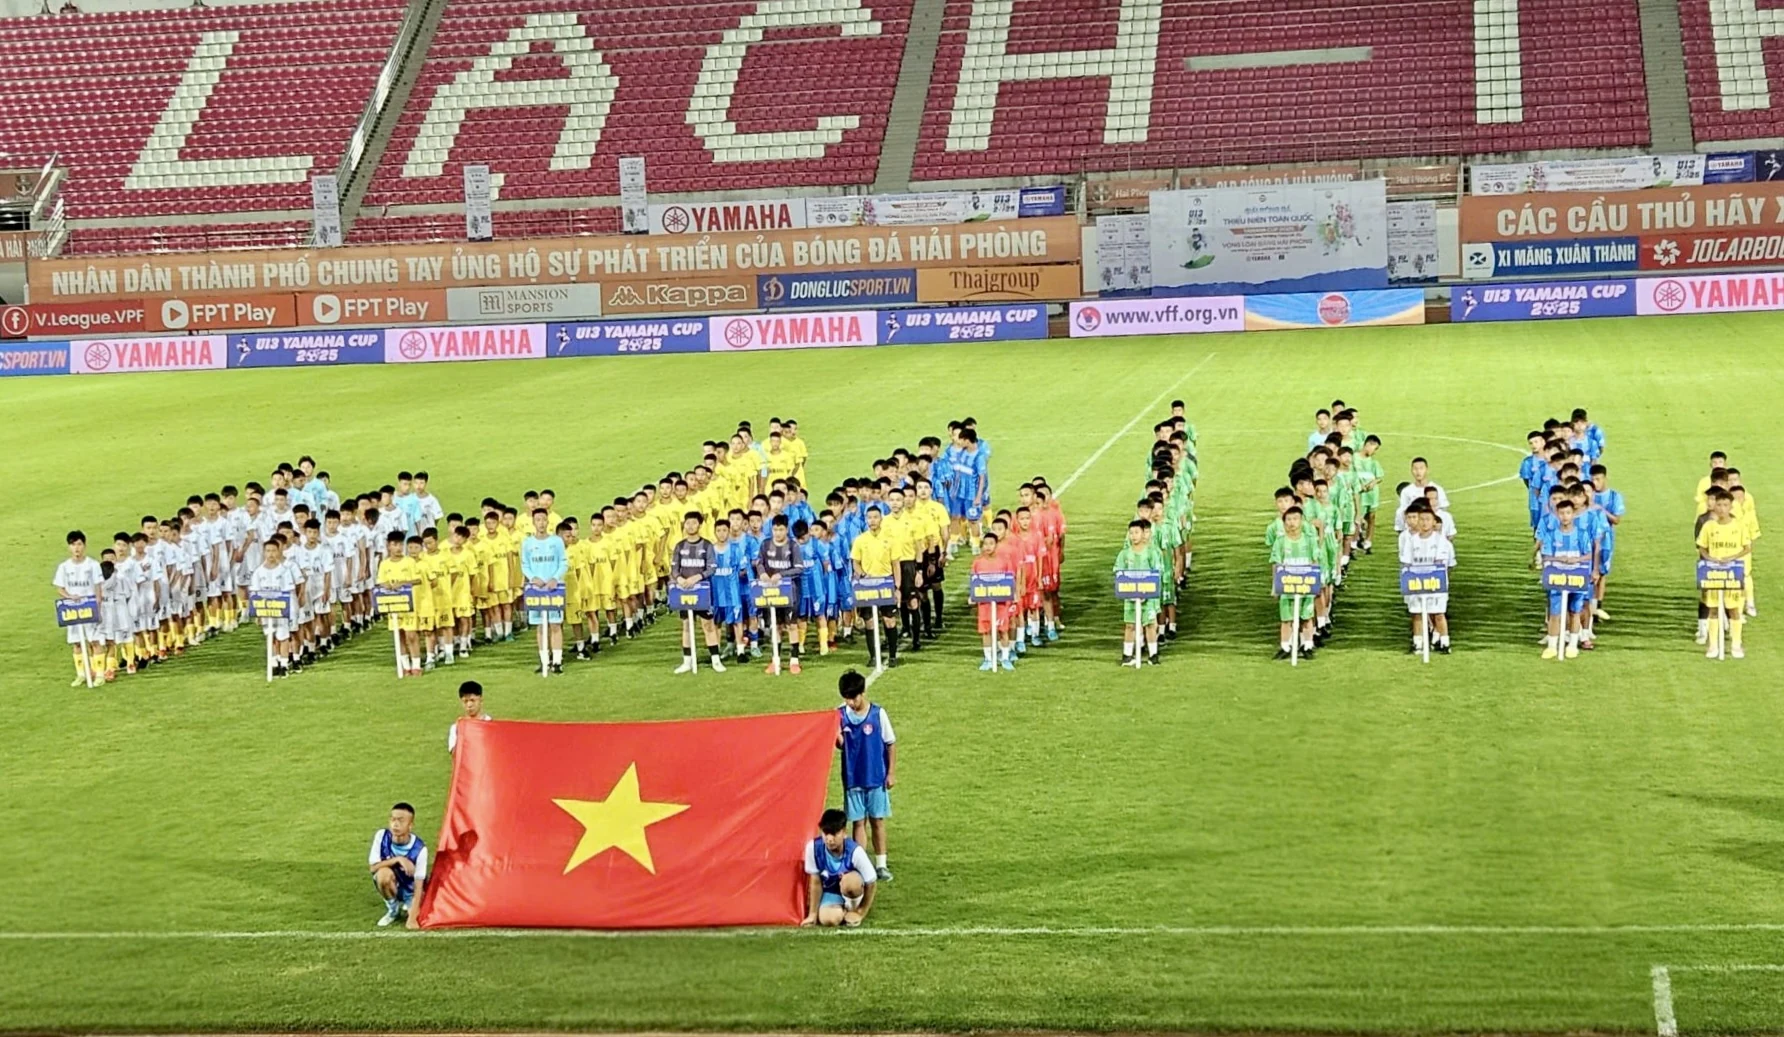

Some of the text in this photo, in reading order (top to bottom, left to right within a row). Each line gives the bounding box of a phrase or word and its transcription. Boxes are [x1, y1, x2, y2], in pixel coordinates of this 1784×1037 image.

[691, 202, 793, 233] YAMAHA
[1496, 203, 1557, 237] CÁC
[1567, 195, 1628, 233] CẦU
[1637, 192, 1695, 230] THỦ
[1705, 193, 1767, 227] HÃY
[52, 226, 1047, 296] NHÂN DÂN THÀNH PHỐ CHUNG TAY ỦNG HỘ SỰ PHÁT TRIỂN CỦA BÓNG ĐÁ HẢI PHÒNG
[1497, 241, 1636, 268] XI MĂNG XUÂN THÀNH
[790, 277, 912, 300] DONGLUCSPORT.VN
[949, 268, 1040, 293] Thaigroup
[507, 288, 569, 302] MANSION
[647, 284, 747, 308] Kappa
[1482, 284, 1627, 304] U13 YAMAHA CUP
[35, 309, 145, 329] V.League.VPF
[192, 302, 277, 325] FPT Play
[345, 297, 429, 320] FPT Play
[506, 301, 554, 314] SPORTS
[905, 308, 1038, 327] U13 YAMAHA CUP
[1105, 303, 1239, 326] www.vff.org.vn
[575, 322, 703, 340] U13 YAMAHA CUP
[756, 315, 863, 345] YAMAHA
[255, 333, 379, 351] U13 YAMAHA CUP
[430, 328, 533, 358] YAMAHA
[113, 339, 213, 369] YAMAHA
